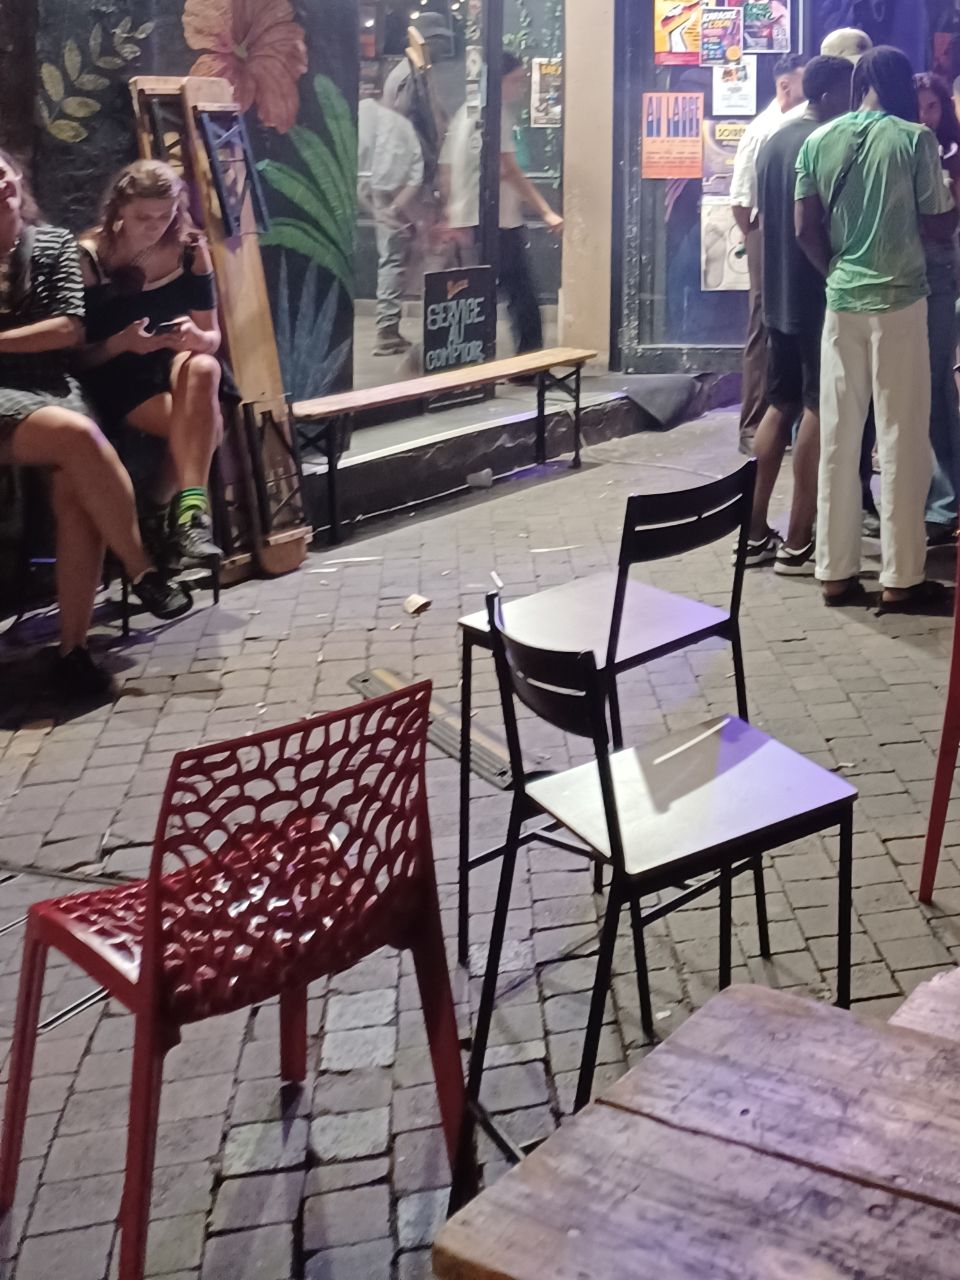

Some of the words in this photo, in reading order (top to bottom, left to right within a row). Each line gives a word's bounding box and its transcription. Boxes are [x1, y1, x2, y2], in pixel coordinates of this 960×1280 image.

[426, 297, 485, 331] SERVICE
[447, 321, 465, 345] AU
[425, 340, 486, 370] COMPTOIR
